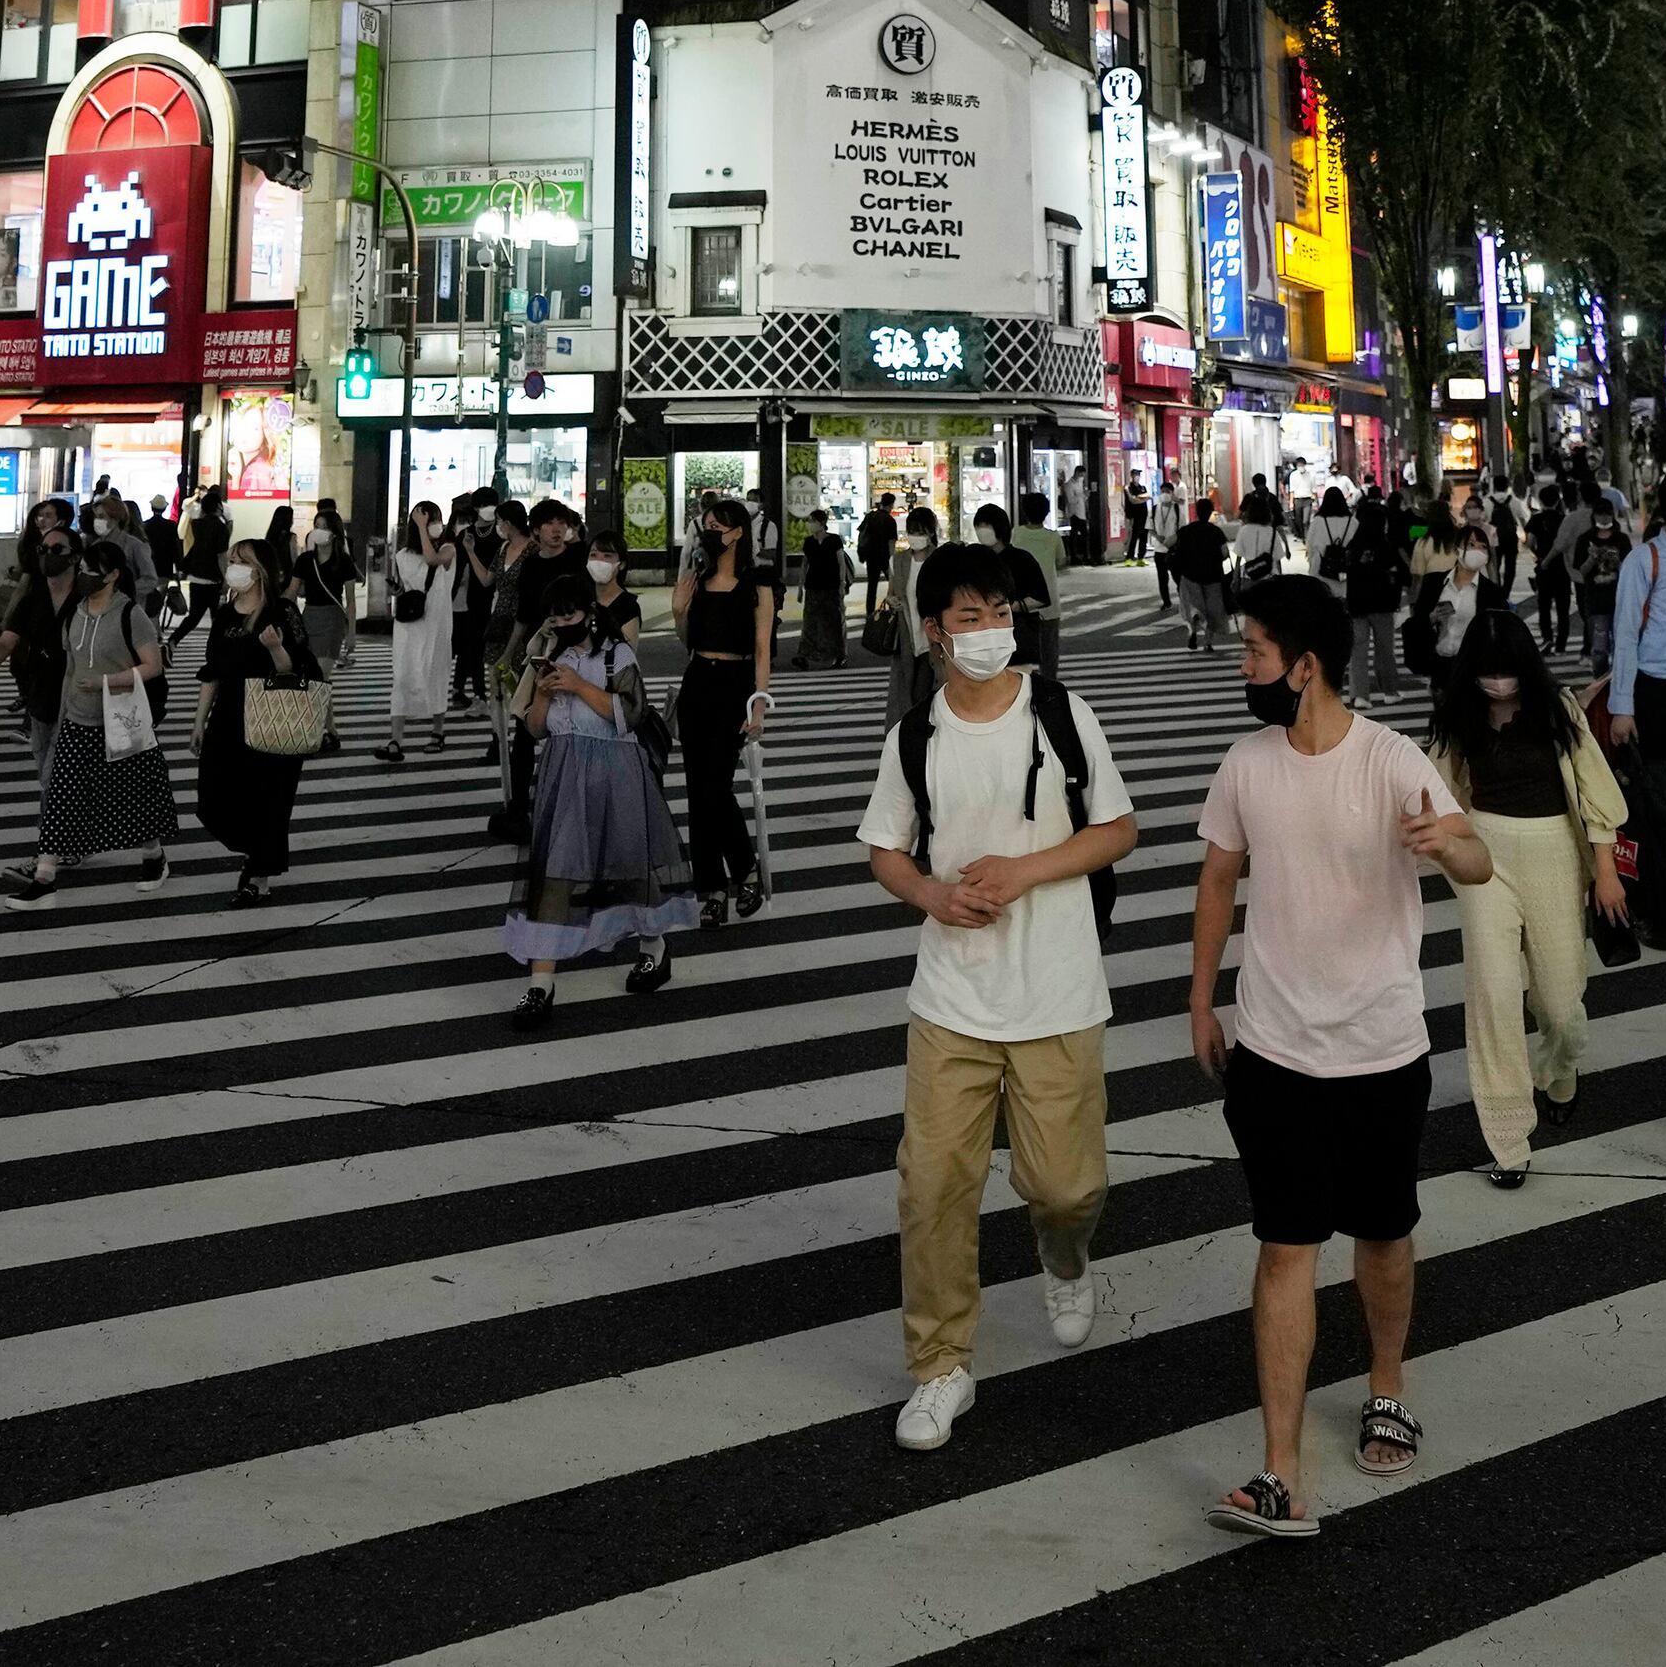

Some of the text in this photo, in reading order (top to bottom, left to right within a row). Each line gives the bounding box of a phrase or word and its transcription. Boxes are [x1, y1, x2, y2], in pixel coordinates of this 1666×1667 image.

[891, 24, 927, 66] 質
[825, 83, 981, 109] 高価買取 激安販売
[1109, 72, 1135, 101] 質
[850, 118, 960, 144] HERMÈS
[834, 142, 976, 168] LOUIS VUITTON
[862, 169, 949, 190] ROLEX
[859, 192, 953, 215] Cartier
[850, 215, 964, 237] BVLGARI
[1224, 198, 1240, 278] クロサワ
[852, 237, 961, 261] CHANEL
[44, 255, 171, 330] GAME
[1210, 238, 1226, 334] バイオリン
[43, 331, 165, 357] TAITO STATION
[869, 324, 965, 373] 銀蔵
[880, 418, 929, 436] SALE
[627, 500, 663, 517] SALE
[1375, 1398, 1399, 1414] OFF
[1373, 1424, 1408, 1442] WALL
